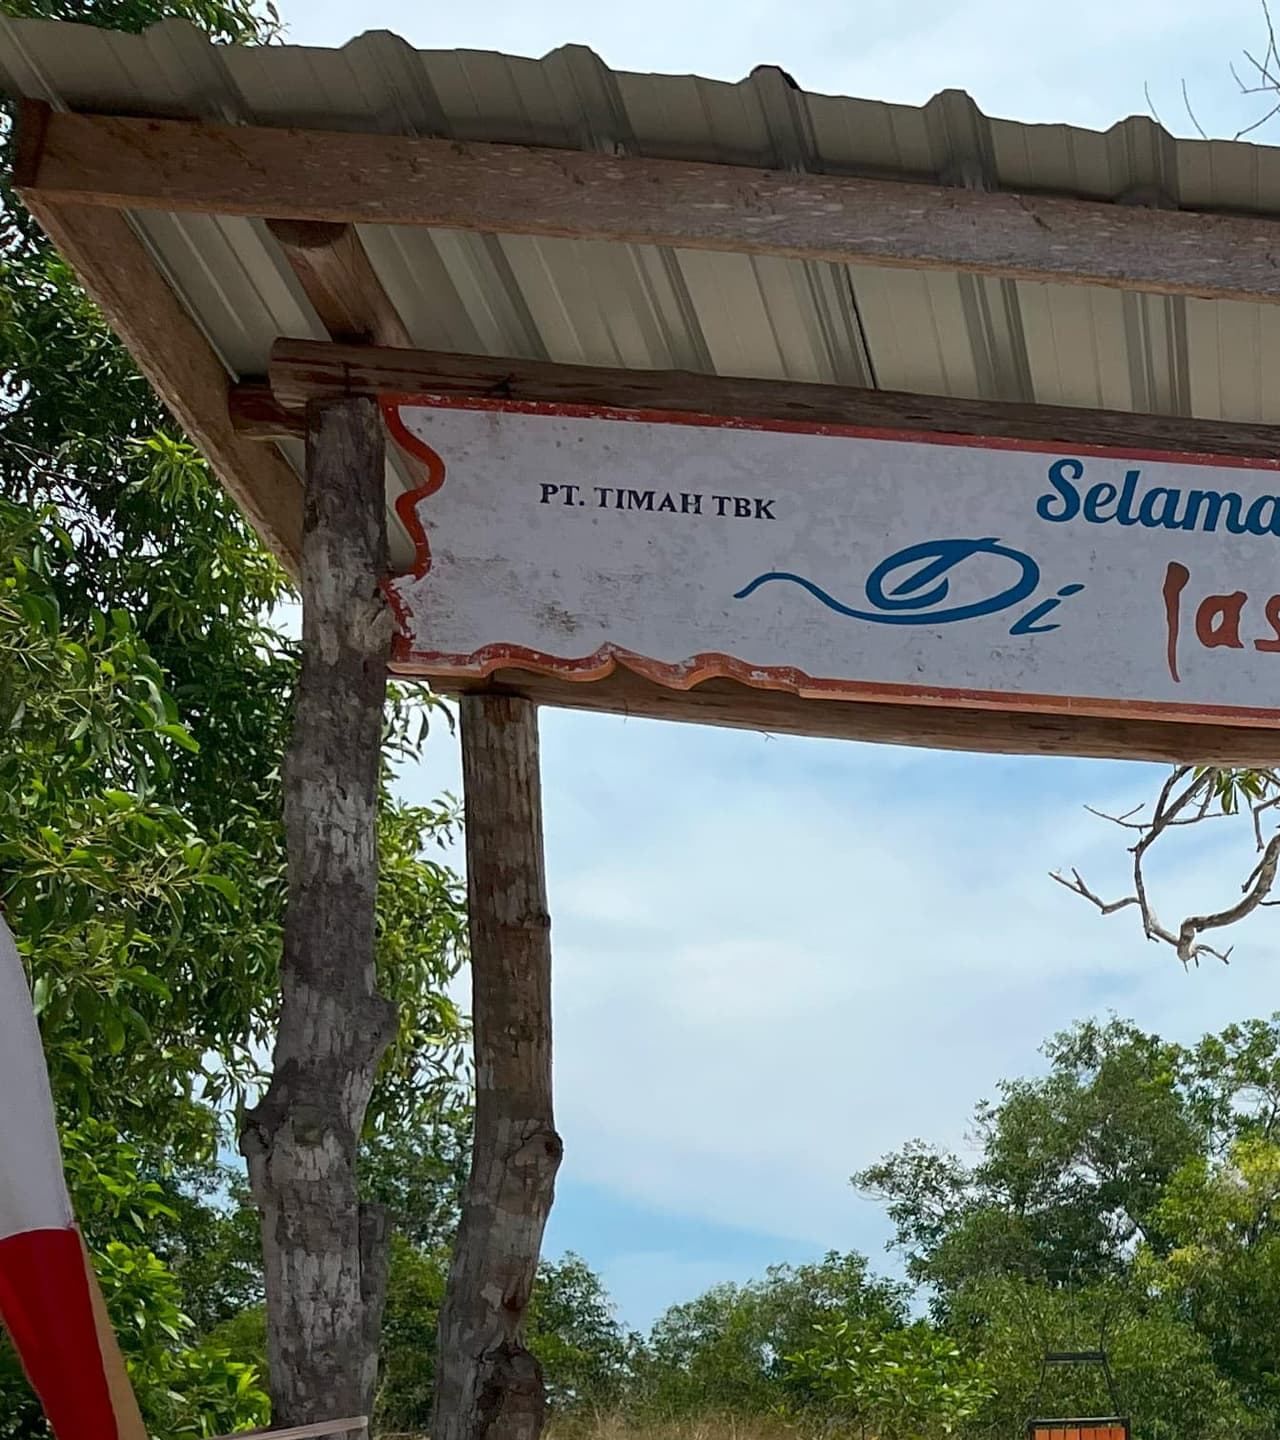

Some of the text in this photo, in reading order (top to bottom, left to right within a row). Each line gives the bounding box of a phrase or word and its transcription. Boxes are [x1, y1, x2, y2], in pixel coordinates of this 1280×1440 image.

[538, 482, 778, 521] PT. TIMAH TBK
